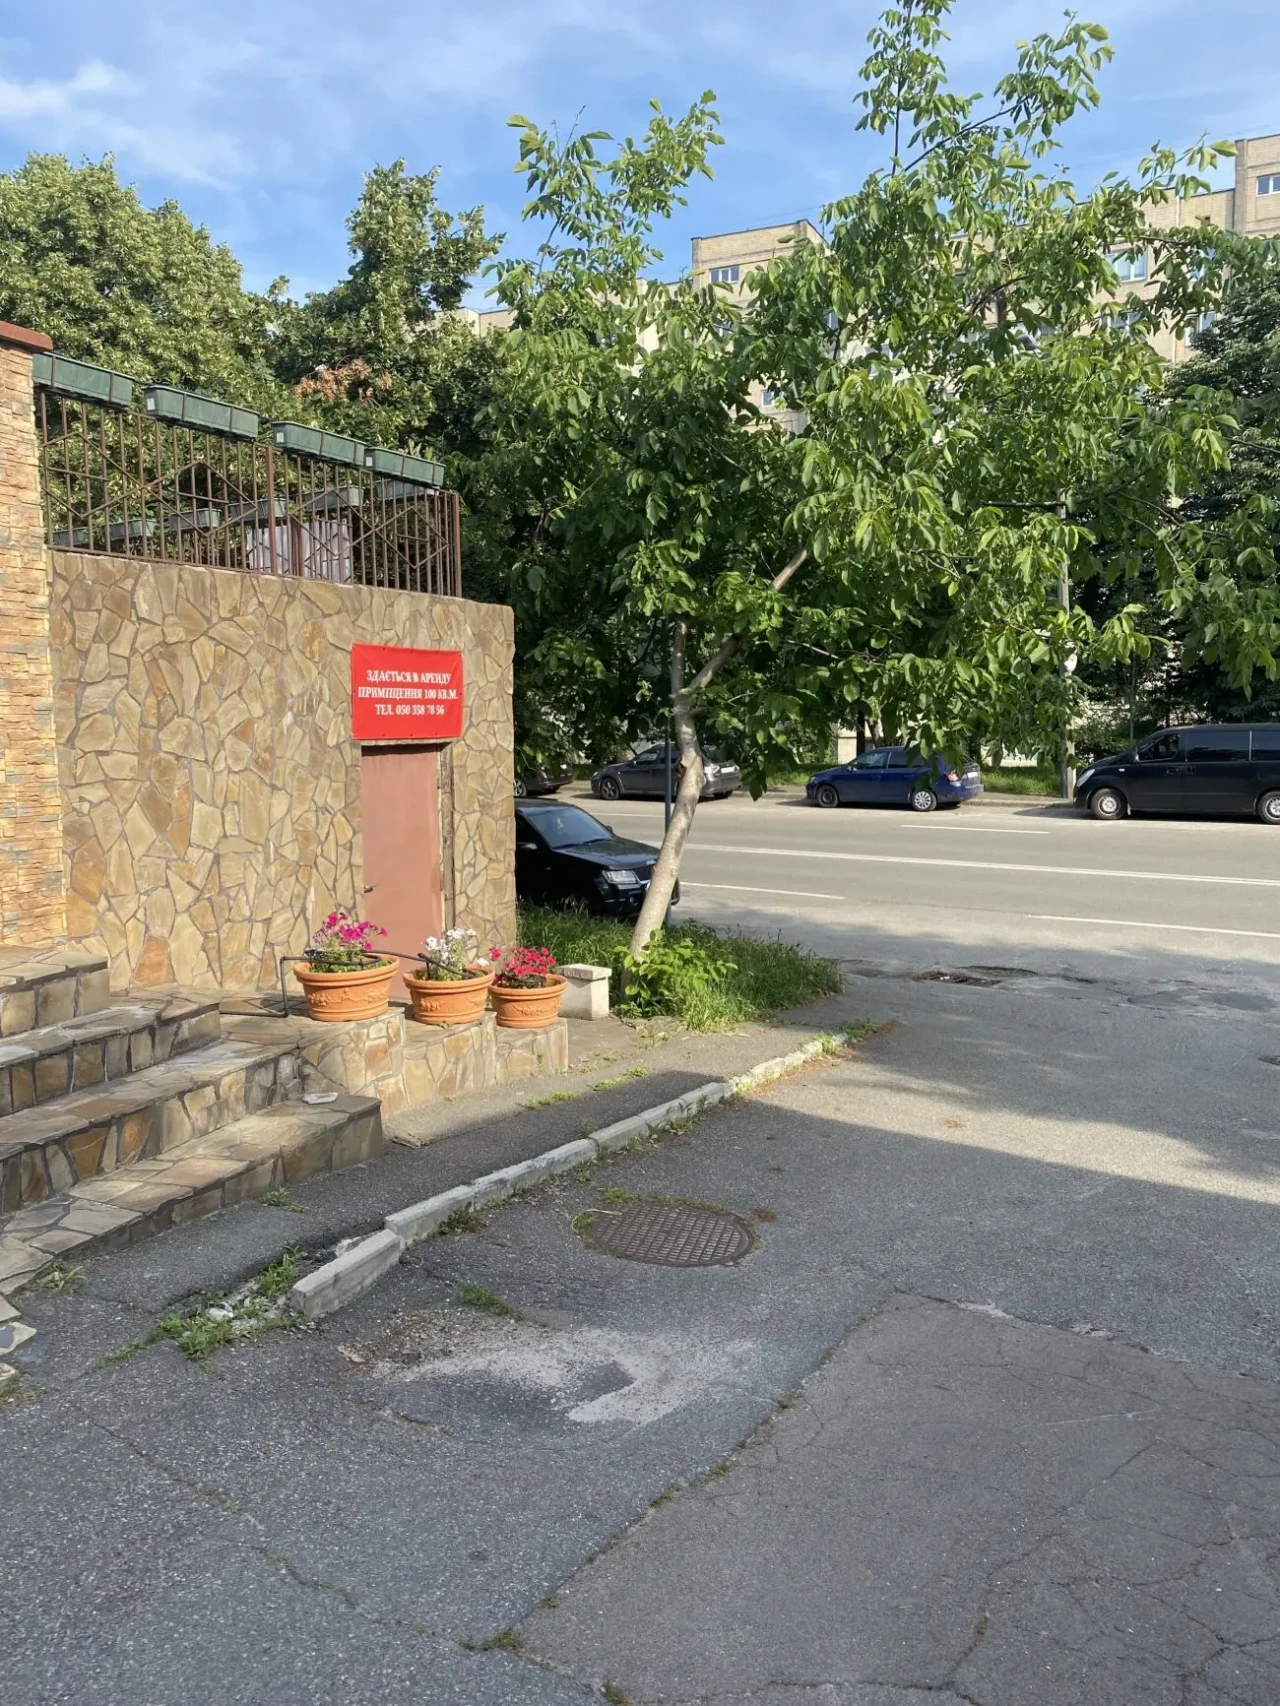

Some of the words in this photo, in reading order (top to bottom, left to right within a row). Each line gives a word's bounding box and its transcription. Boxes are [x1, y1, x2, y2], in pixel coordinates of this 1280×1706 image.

[367, 670, 412, 683] ЗДАЄТЬСЯ
[413, 672, 419, 682] В
[421, 673, 451, 685] АРЕНДУ
[358, 687, 422, 700] ПРИМІЩЕННЯ
[424, 689, 436, 699] 100
[437, 690, 457, 699] КВ.М.
[375, 704, 393, 715] ТЕЛ.
[396, 705, 410, 715] 050
[412, 705, 425, 715] 358
[427, 705, 435, 715] 78
[436, 705, 445, 715] 56
